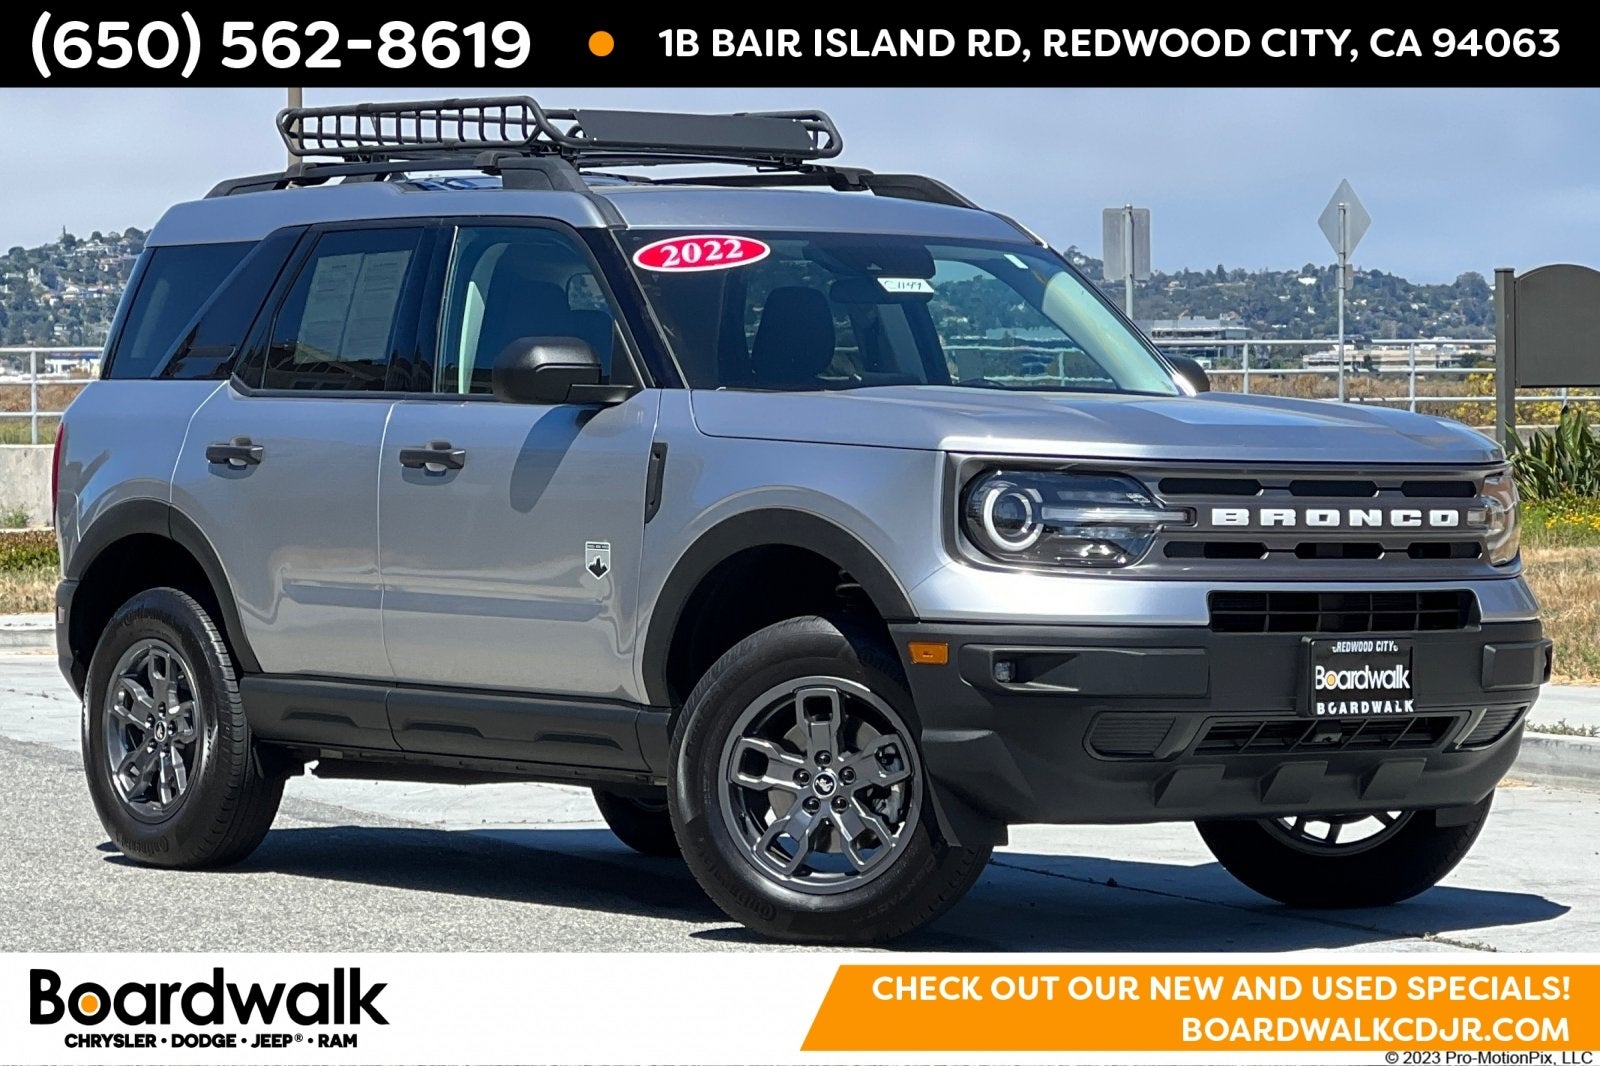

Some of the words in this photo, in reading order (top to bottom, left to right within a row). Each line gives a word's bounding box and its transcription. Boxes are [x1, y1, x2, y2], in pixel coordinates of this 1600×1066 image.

[660, 239, 744, 268] 2022
[1212, 508, 1459, 527] BRONCO
[1335, 641, 1374, 653] REDWOOD
[1375, 640, 1395, 653] CITY
[1315, 664, 1411, 691] Boardwalk
[1316, 699, 1415, 716] BOARDWALK
